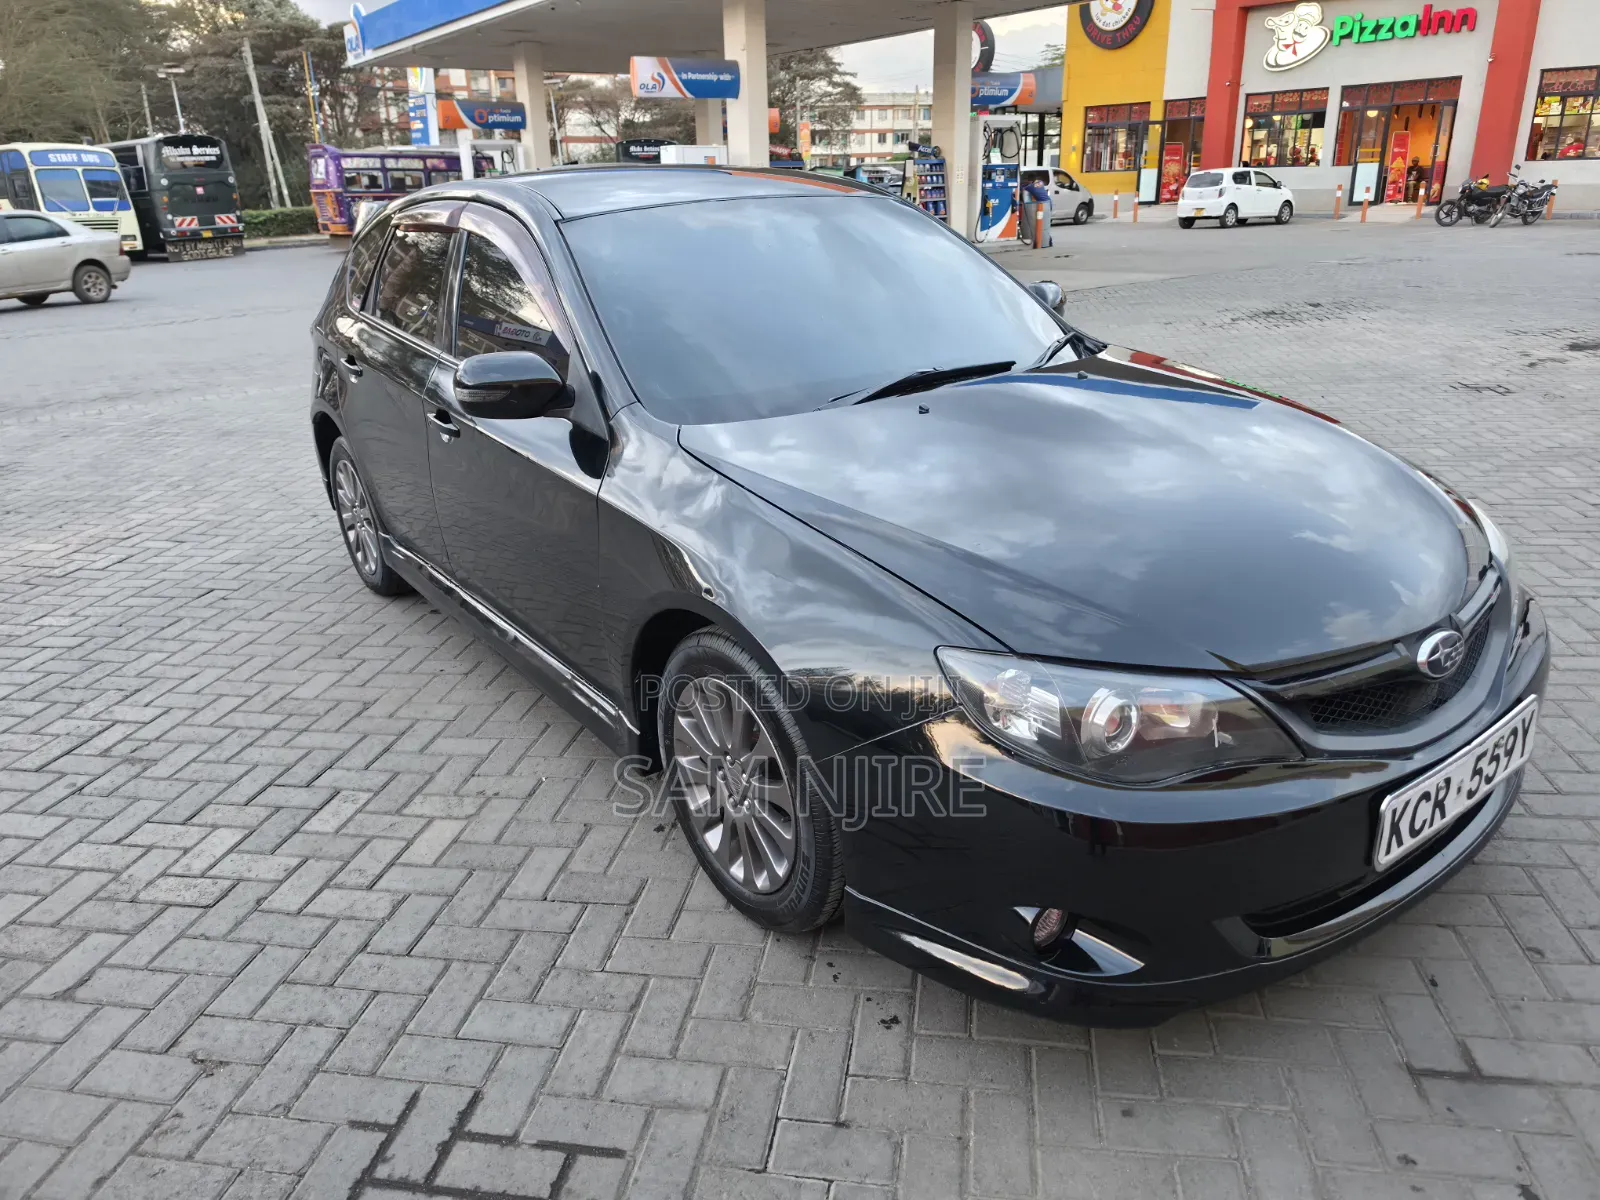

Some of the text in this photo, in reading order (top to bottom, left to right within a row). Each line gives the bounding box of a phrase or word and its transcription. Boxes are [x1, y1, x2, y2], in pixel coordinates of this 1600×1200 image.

[1112, 7, 1132, 28] chicken
[1086, 15, 1142, 45] DRIVE THRU
[687, 72, 718, 82] Partnership
[48, 153, 100, 164] STAFF BUS
[1385, 708, 1536, 857] KCR 559Y
